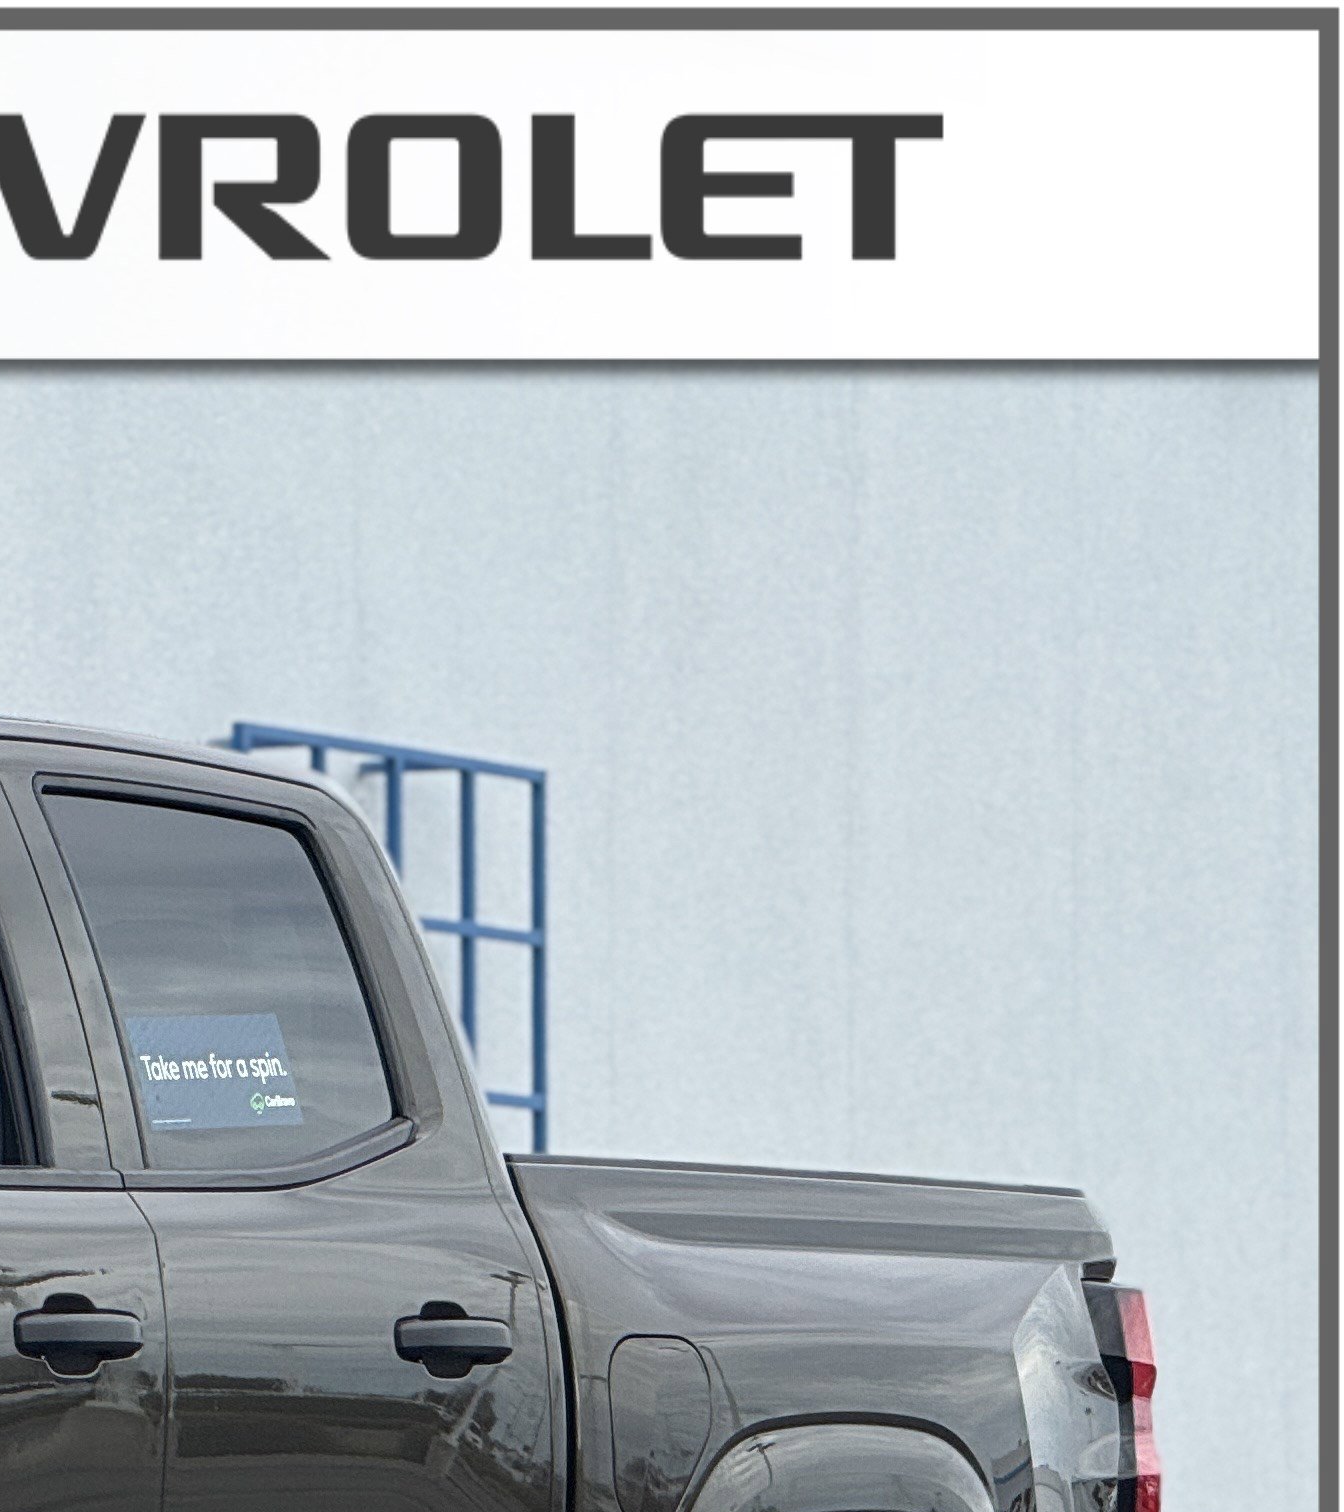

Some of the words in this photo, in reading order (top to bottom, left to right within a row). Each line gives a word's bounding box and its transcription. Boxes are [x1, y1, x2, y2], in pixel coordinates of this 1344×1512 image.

[139, 1055, 181, 1081] Take
[181, 1060, 209, 1080] me
[209, 1053, 232, 1079] for
[235, 1058, 249, 1078] a
[249, 1051, 288, 1084] spin.
